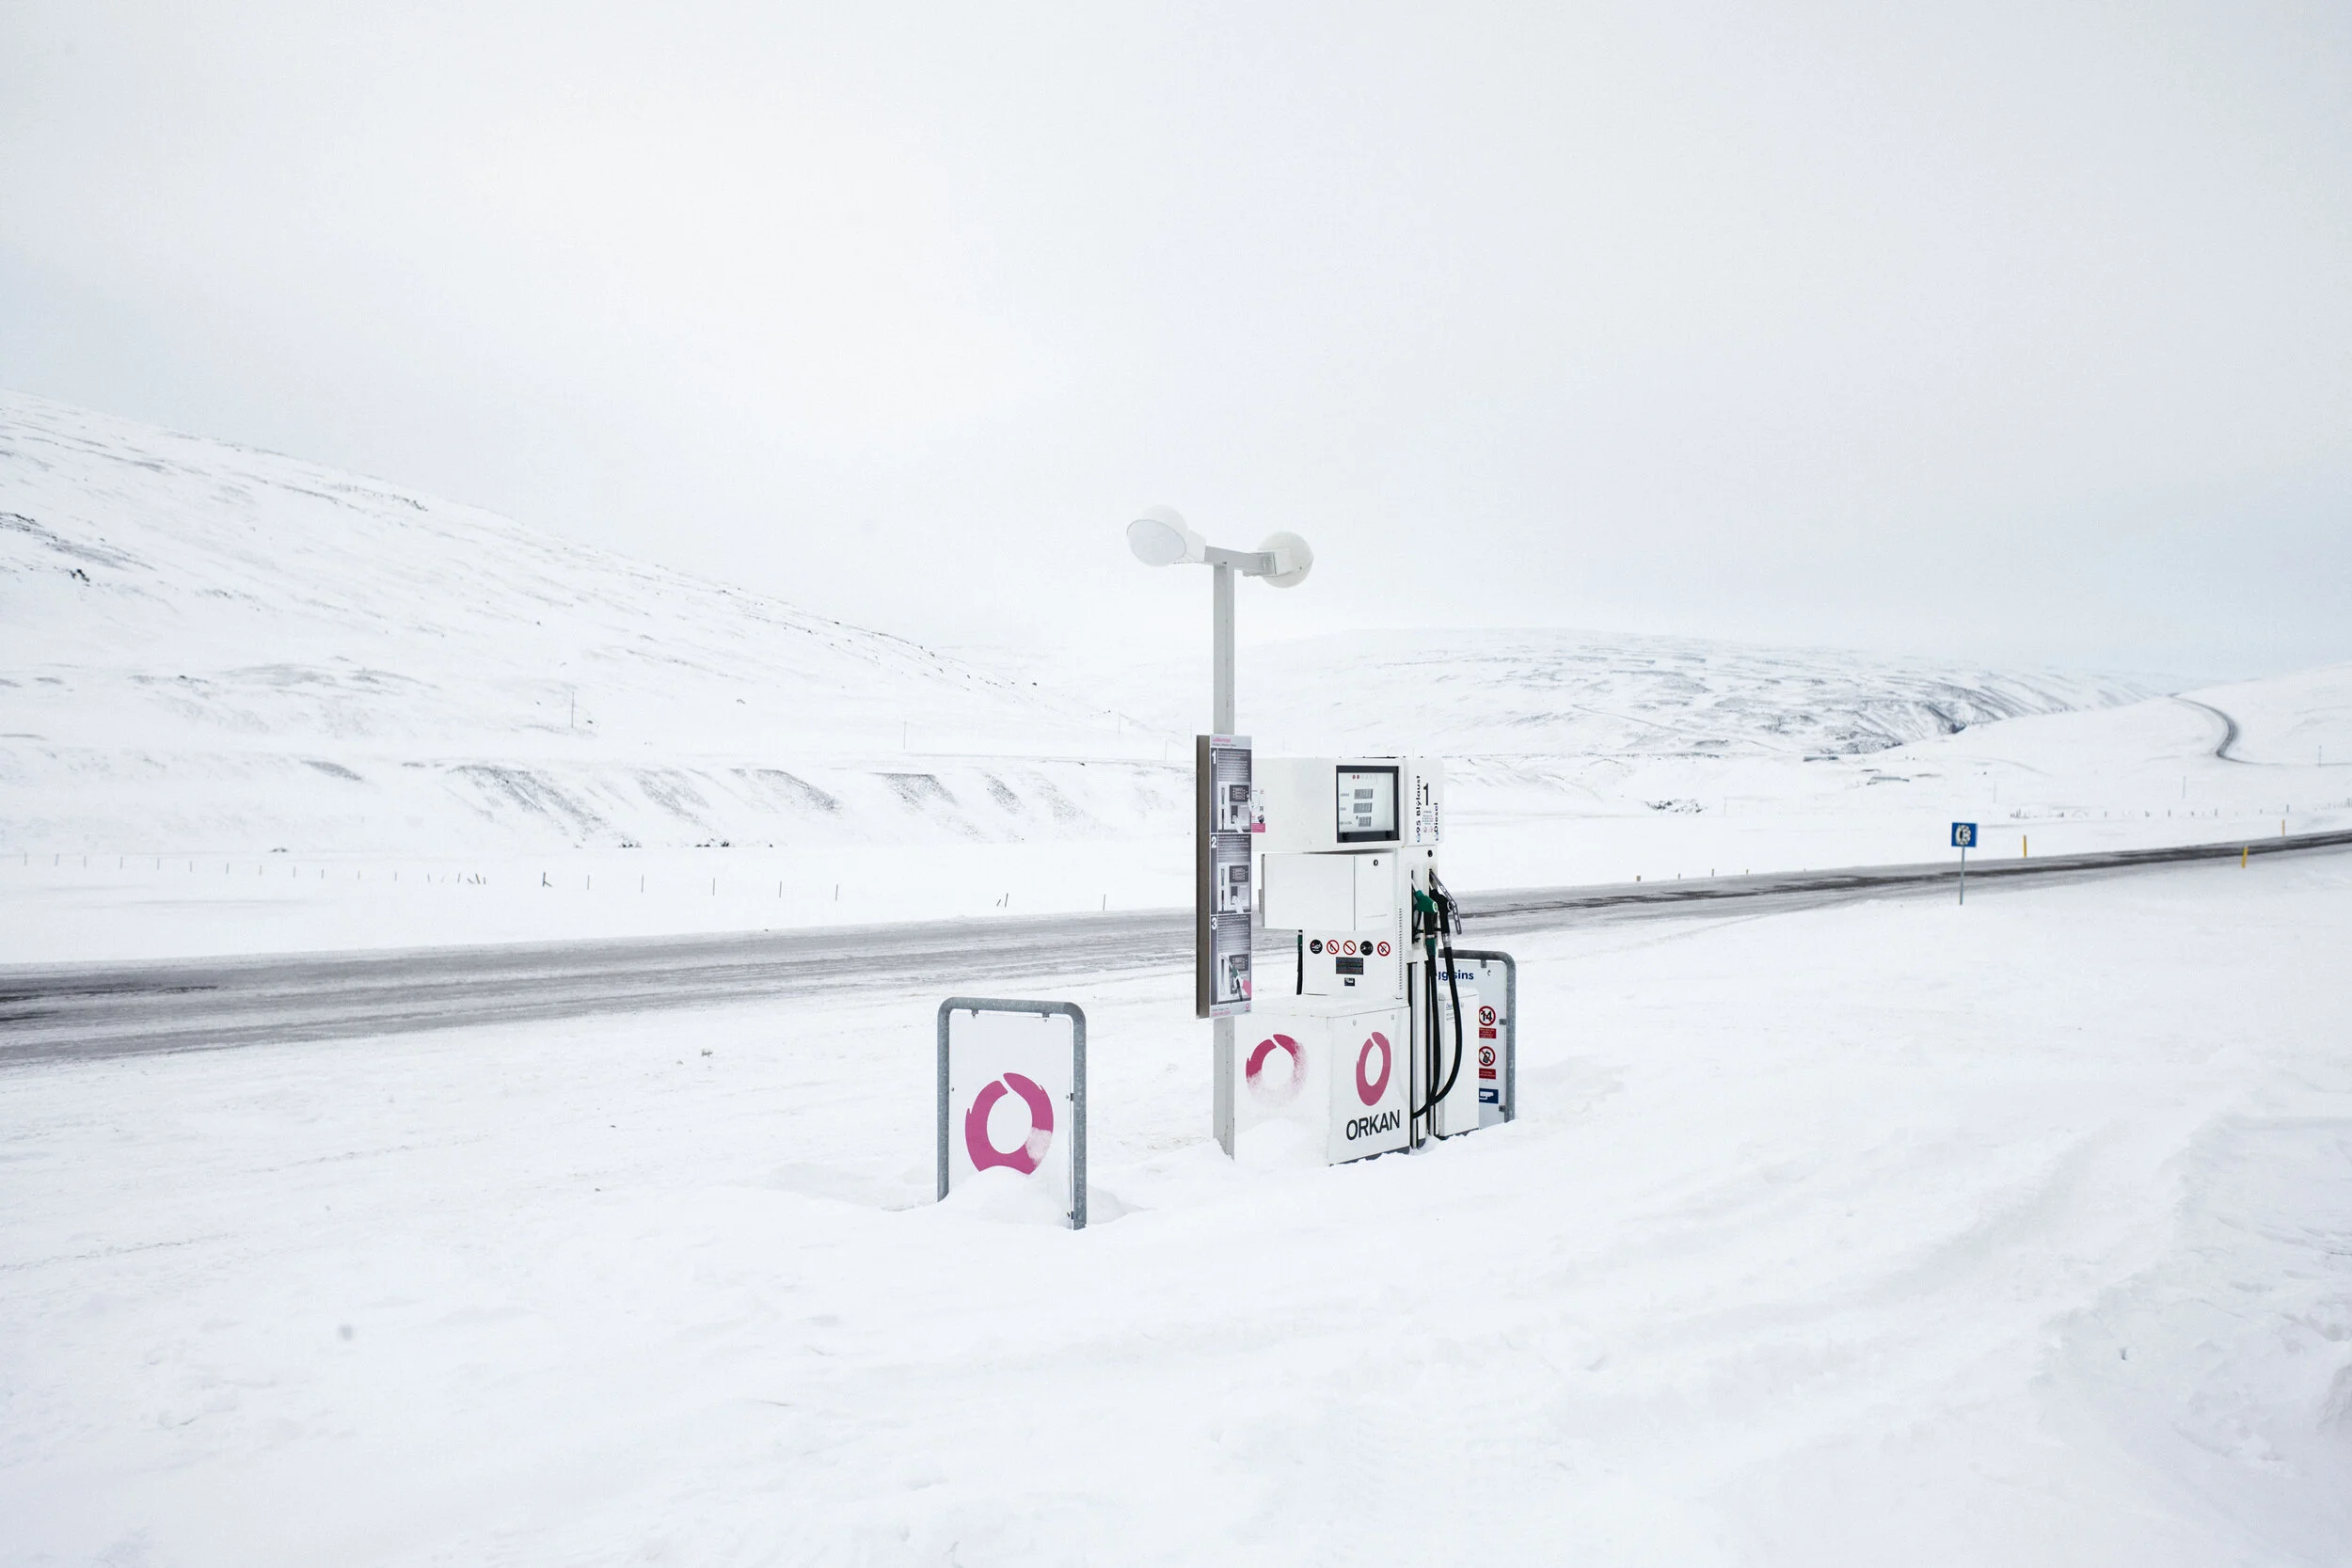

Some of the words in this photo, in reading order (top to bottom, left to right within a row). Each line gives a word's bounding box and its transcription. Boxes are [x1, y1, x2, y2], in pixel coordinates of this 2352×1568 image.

[1212, 751, 1216, 765] 1
[1423, 783, 1429, 806] 1
[1211, 836, 1217, 848] 2
[1211, 917, 1217, 930] 3
[1481, 1010, 1493, 1022] 14
[1346, 1109, 1400, 1141] ORKAN
